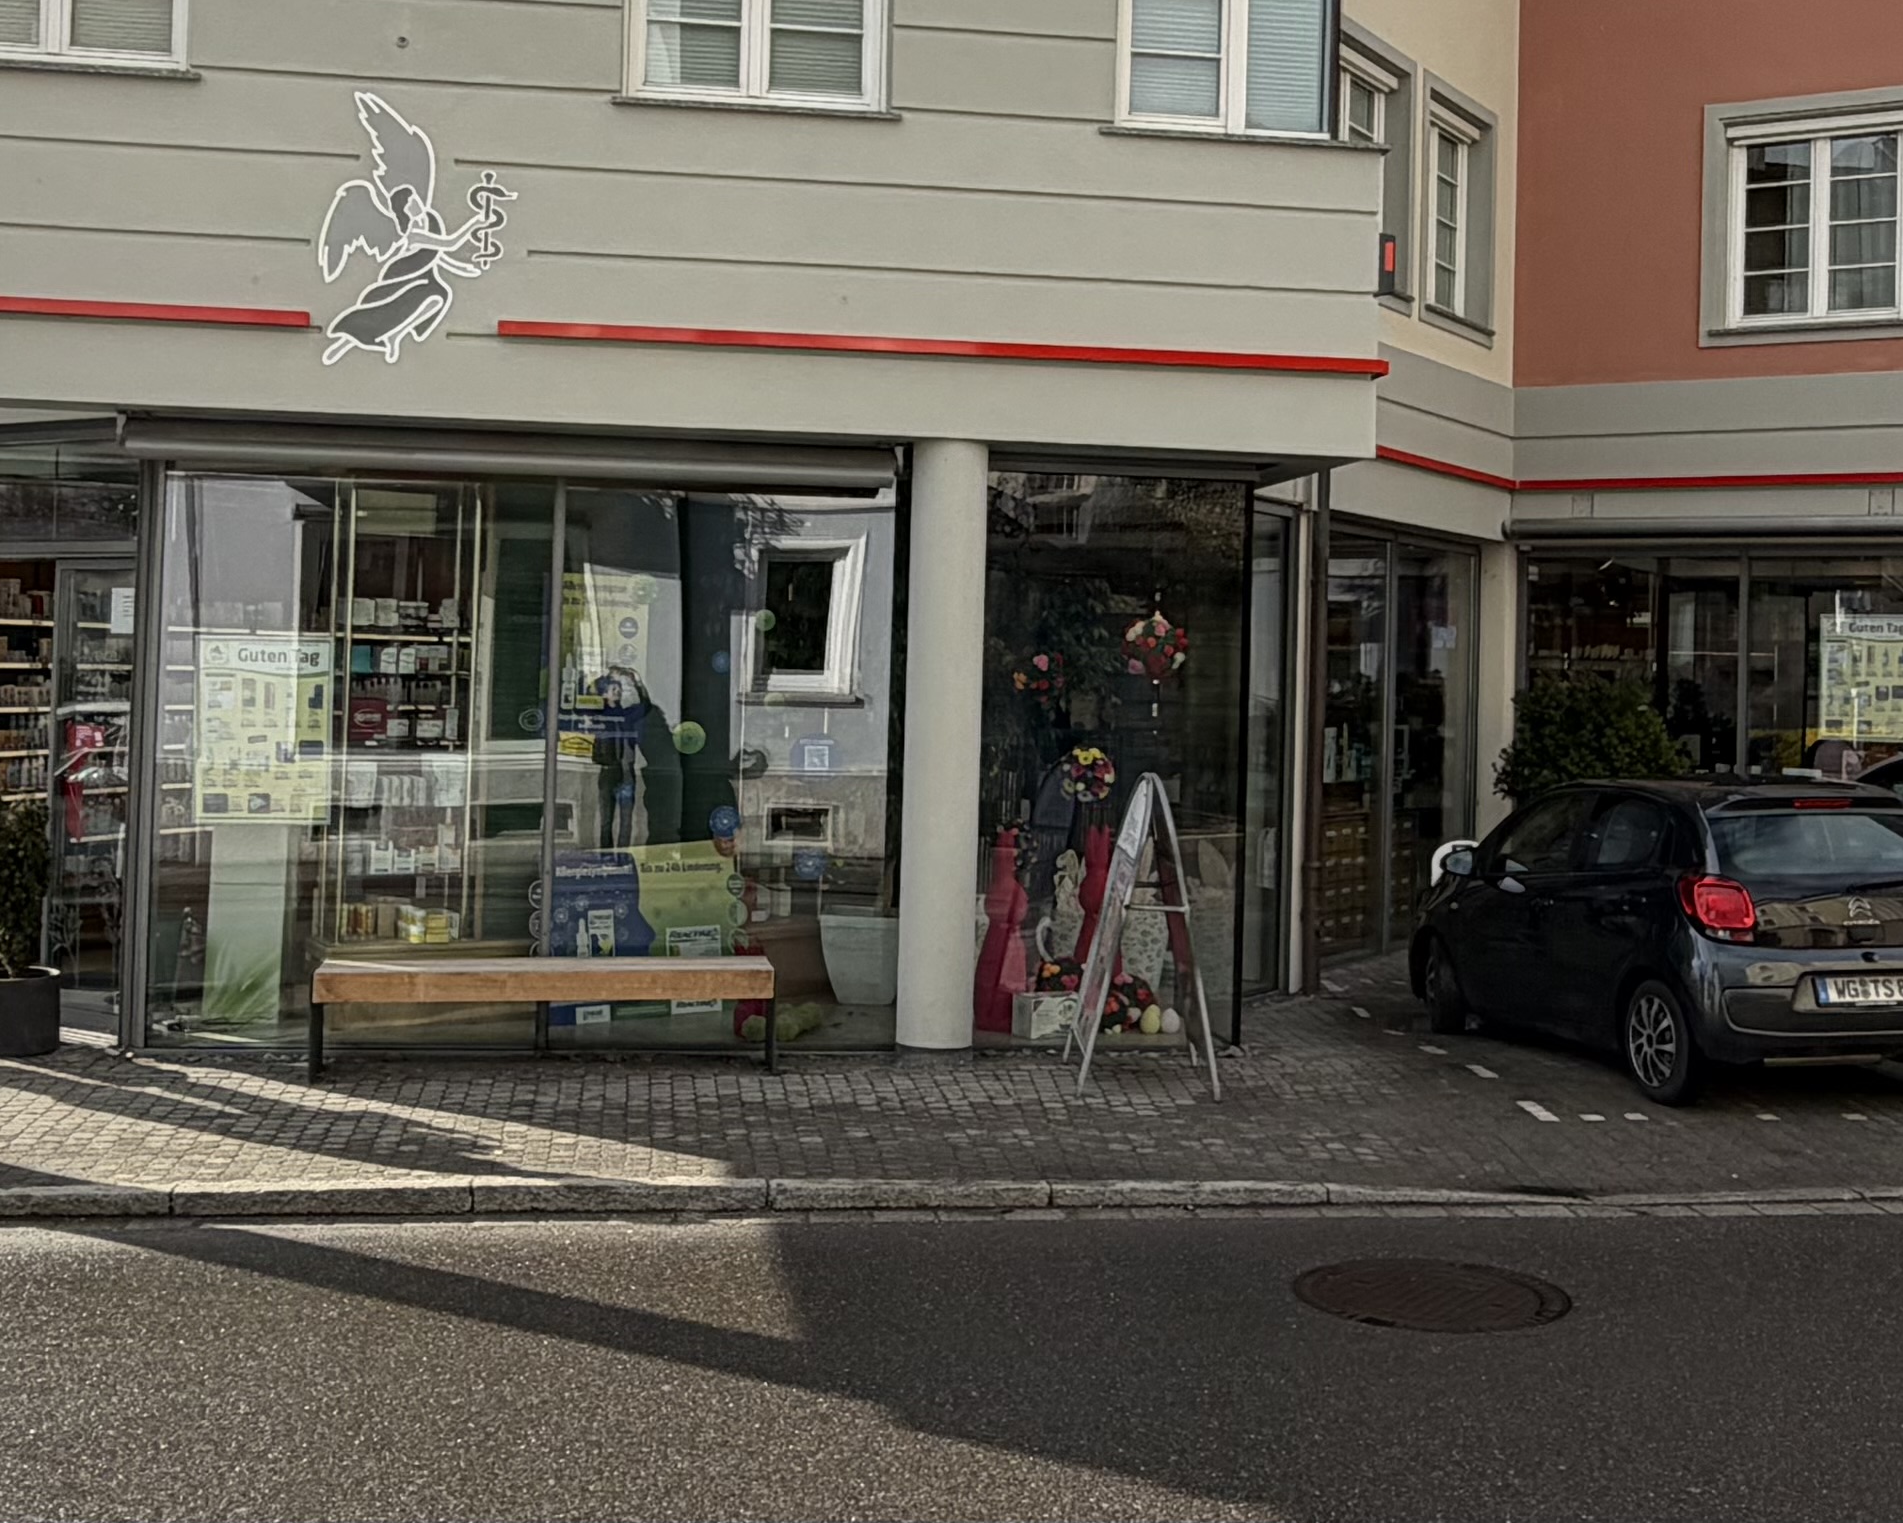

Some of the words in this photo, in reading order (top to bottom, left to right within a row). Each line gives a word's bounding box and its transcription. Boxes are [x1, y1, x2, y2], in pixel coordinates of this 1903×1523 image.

[1848, 622, 1884, 634] Guten
[238, 647, 288, 663] Guten
[1833, 979, 1860, 1000] WG
[1869, 978, 1895, 999] TS
